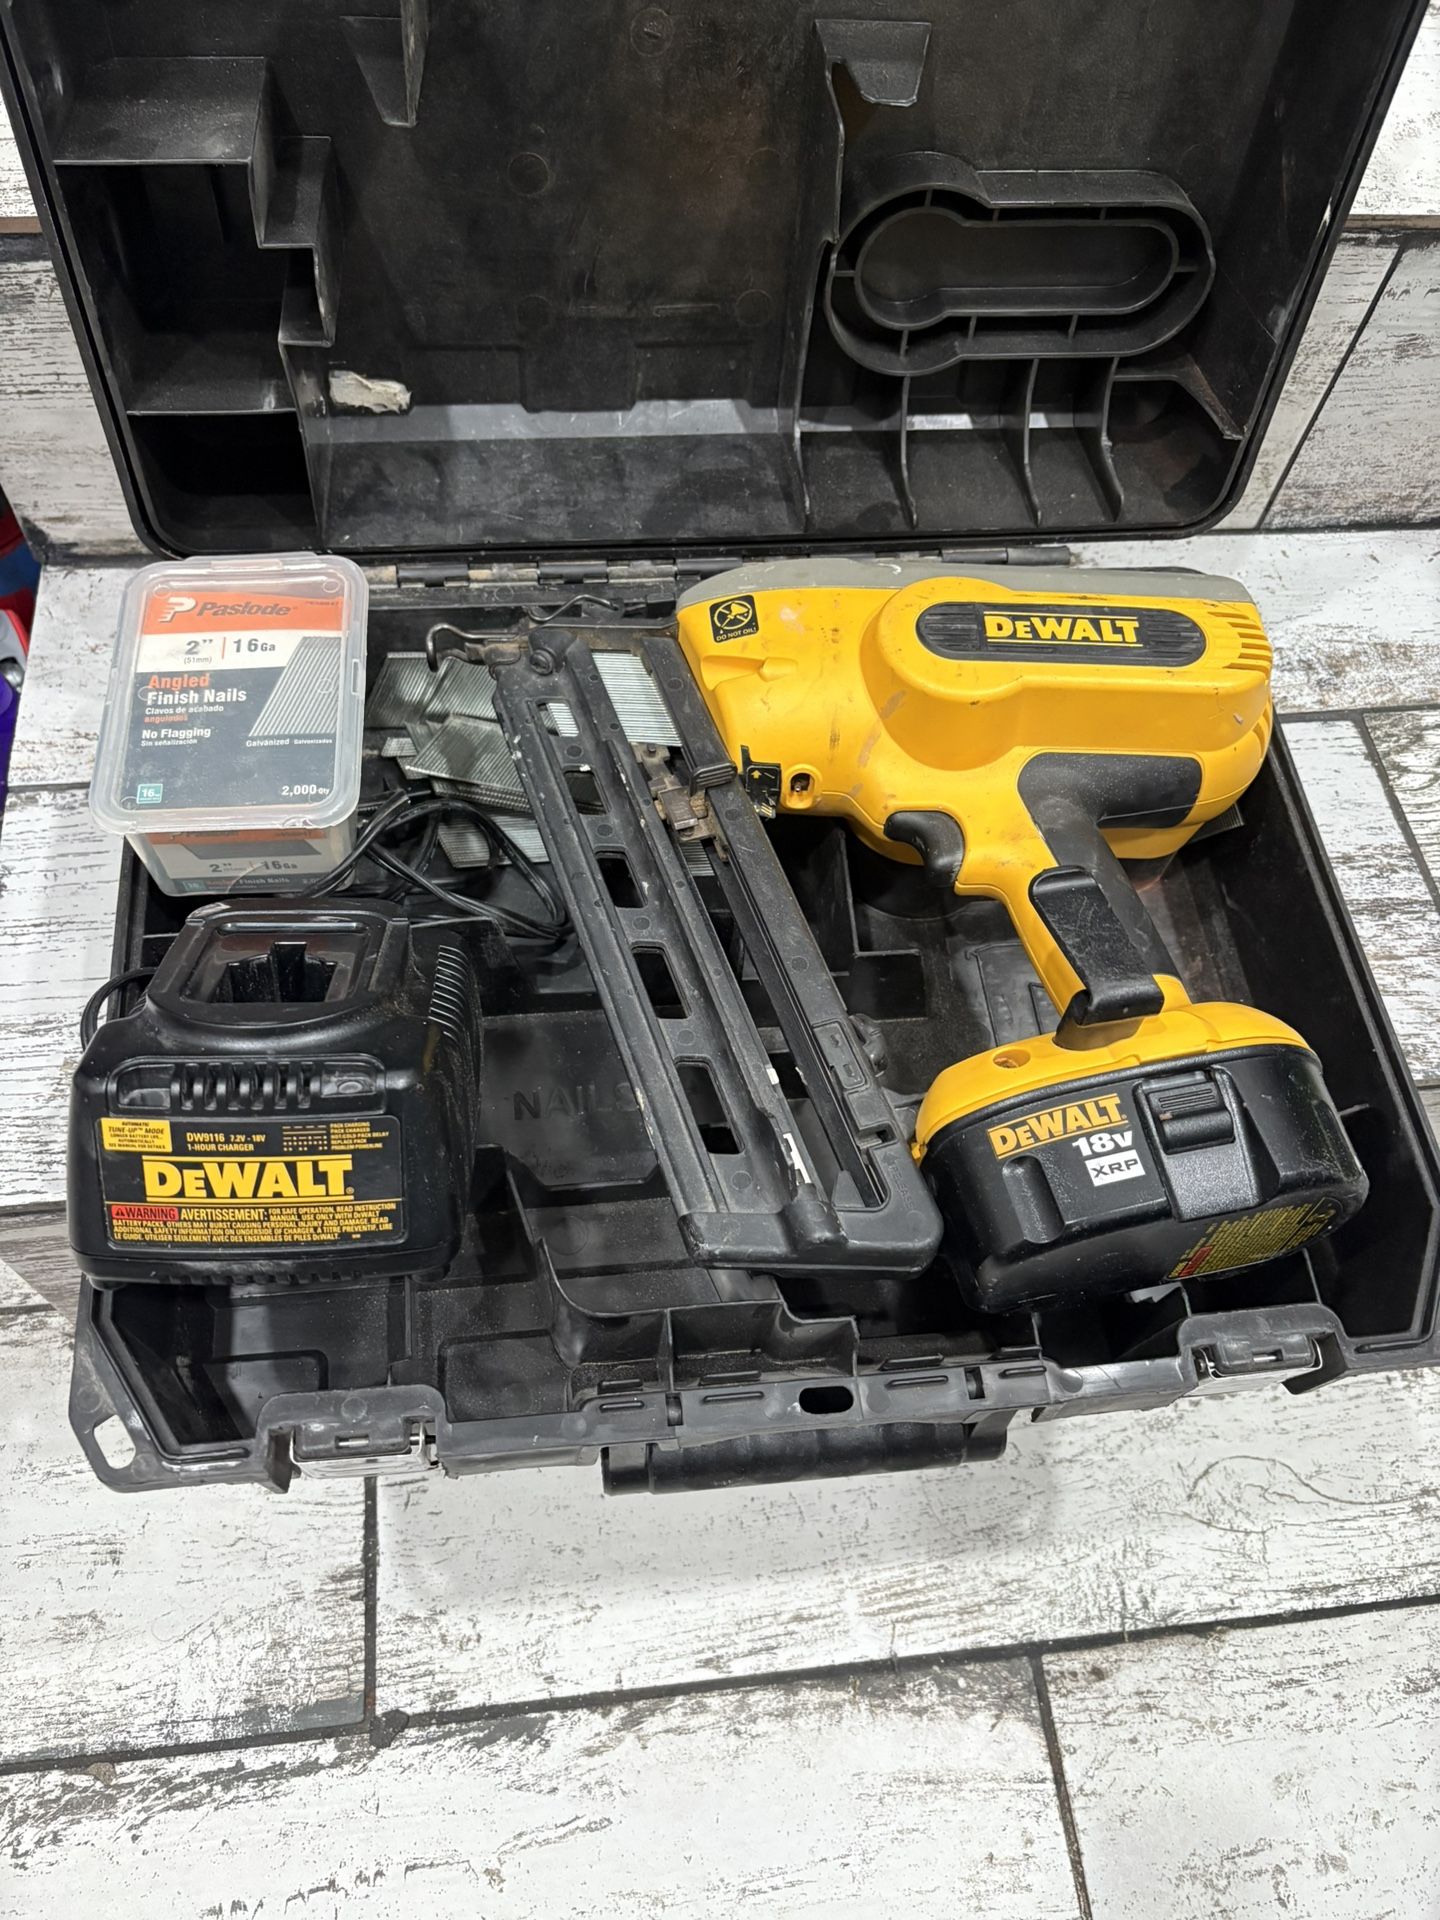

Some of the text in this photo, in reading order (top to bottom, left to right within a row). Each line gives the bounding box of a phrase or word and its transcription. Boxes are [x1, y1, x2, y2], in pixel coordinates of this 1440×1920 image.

[197, 602, 291, 617] Paslode
[728, 630, 742, 638] NOT
[743, 626, 757, 634] OIL!
[184, 656, 212, 665] (51mm)
[149, 673, 210, 690] Angled
[147, 688, 247, 706] Finish Nails
[145, 707, 174, 716] Clavos
[175, 706, 187, 714] de
[142, 727, 211, 740] No Flagging
[246, 737, 290, 748] Galvanized
[144, 1127, 165, 1135] MODE
[186, 1132, 225, 1142] DW9116
[187, 1143, 254, 1151] 1-HOUR CHARGER
[1090, 1158, 1139, 1178] XRP
[125, 1207, 268, 1221] WARNING AVERTISSEMENT:
[262, 1220, 297, 1228] PERSONAL
